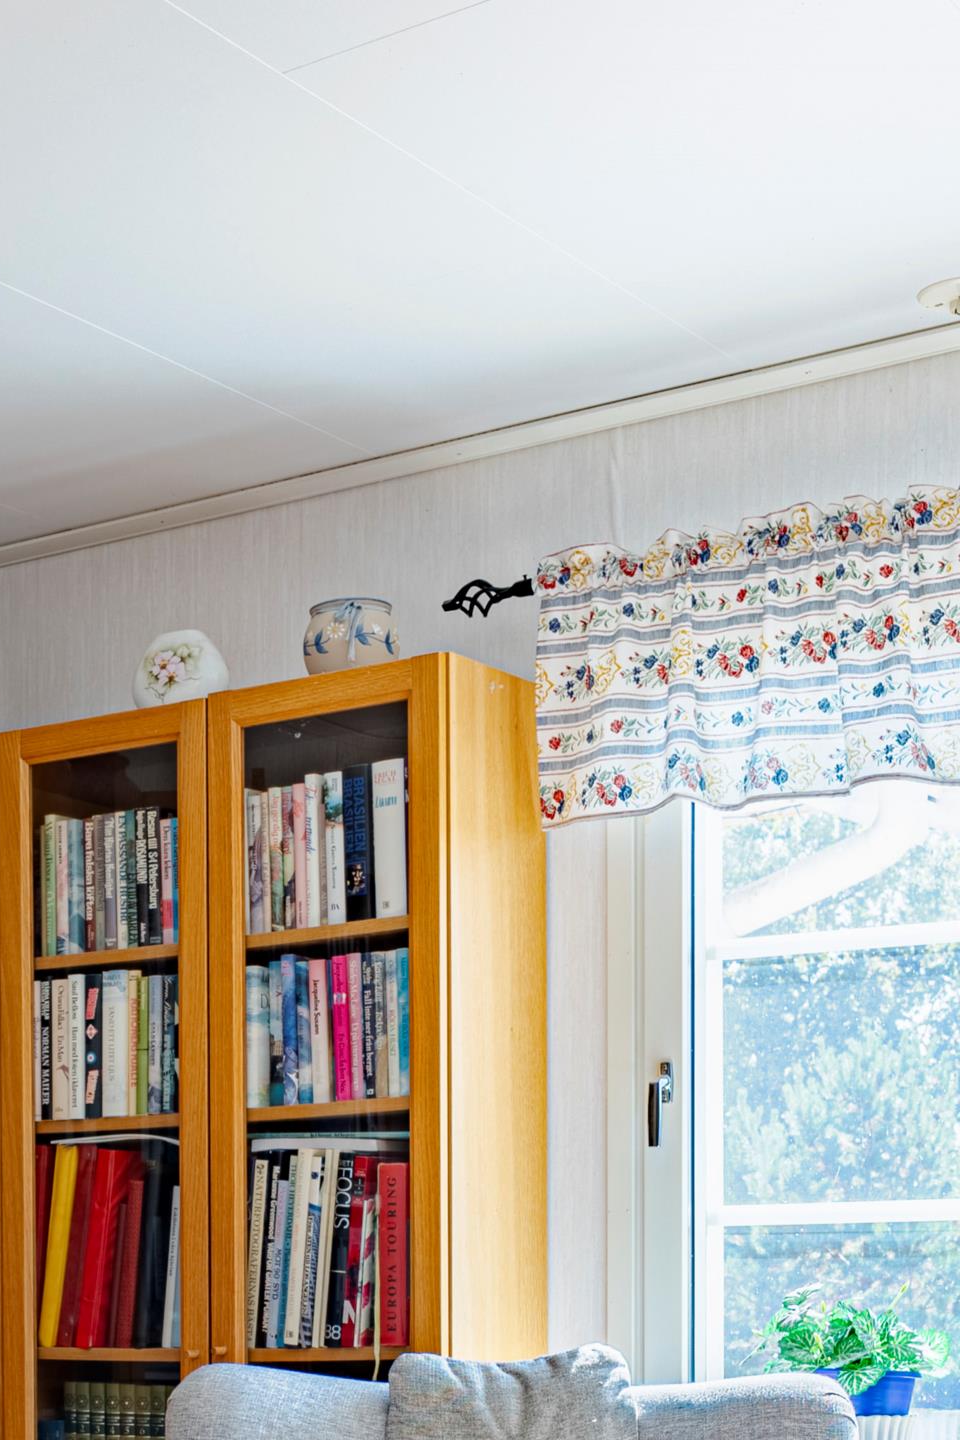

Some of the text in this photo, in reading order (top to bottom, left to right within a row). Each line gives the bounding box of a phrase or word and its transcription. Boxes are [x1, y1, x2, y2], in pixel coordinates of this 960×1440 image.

[343, 776, 367, 852] BRASILIEN BRASILIEN
[148, 863, 159, 910] Petersburg
[312, 979, 320, 1012] Jacqueline
[363, 990, 374, 1077] Fall inte ner från berget
[41, 1026, 50, 1105] NORMAN MAILER
[267, 1200, 277, 1239] Greenwood
[333, 1168, 352, 1229] FOCUS
[248, 1175, 263, 1306] NATURFOTOGRAFERNAS
[387, 1176, 397, 1332] EUROPA TOURING
[272, 1283, 280, 1300] SYD
[274, 1267, 281, 1280] 90
